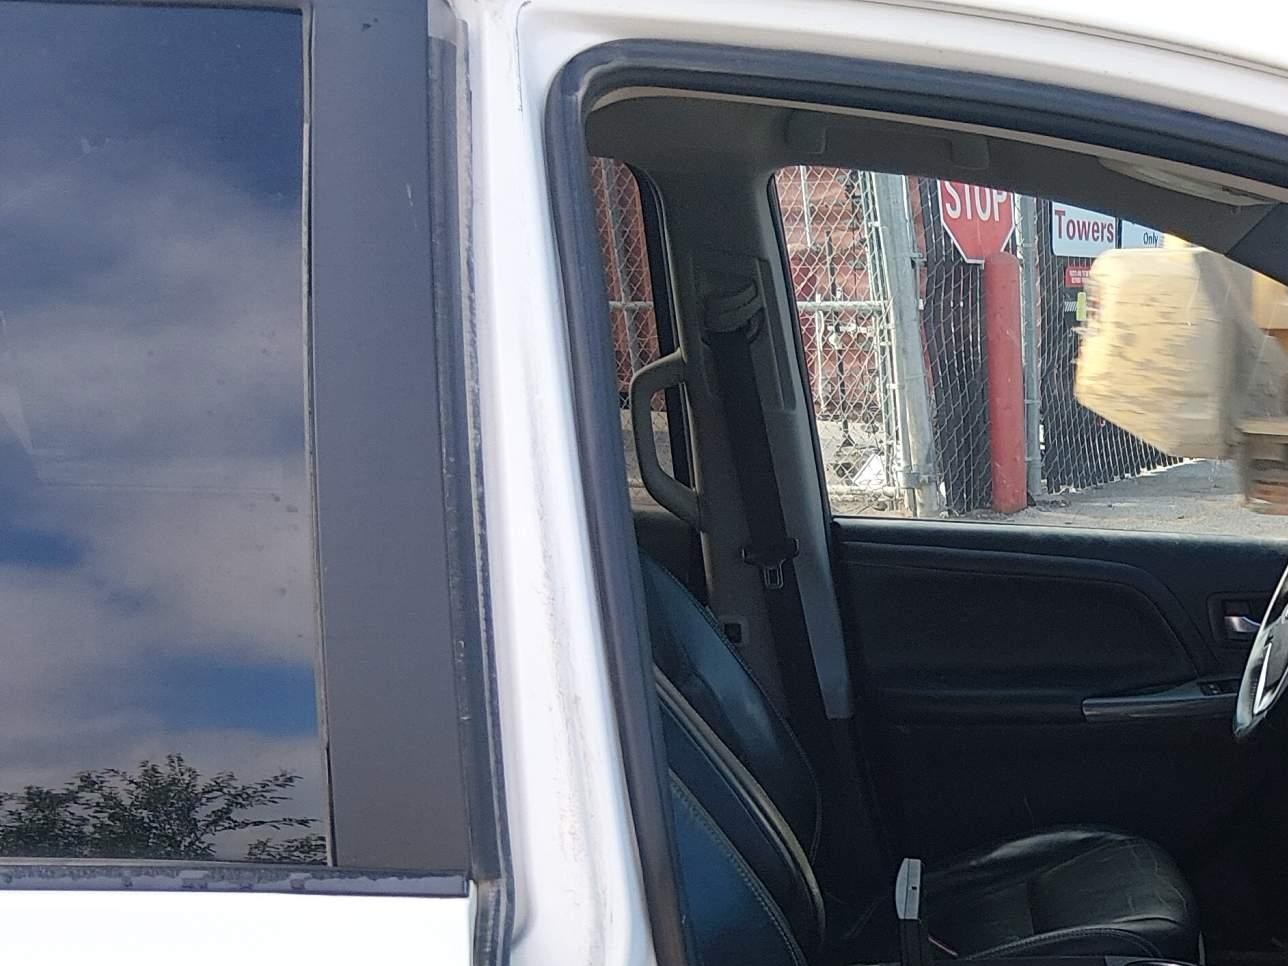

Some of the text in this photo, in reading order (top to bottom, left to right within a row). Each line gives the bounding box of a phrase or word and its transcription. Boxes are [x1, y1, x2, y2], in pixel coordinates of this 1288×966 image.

[944, 180, 1008, 222] STOP
[1054, 208, 1114, 243] Towers
[1143, 231, 1159, 248] Only
